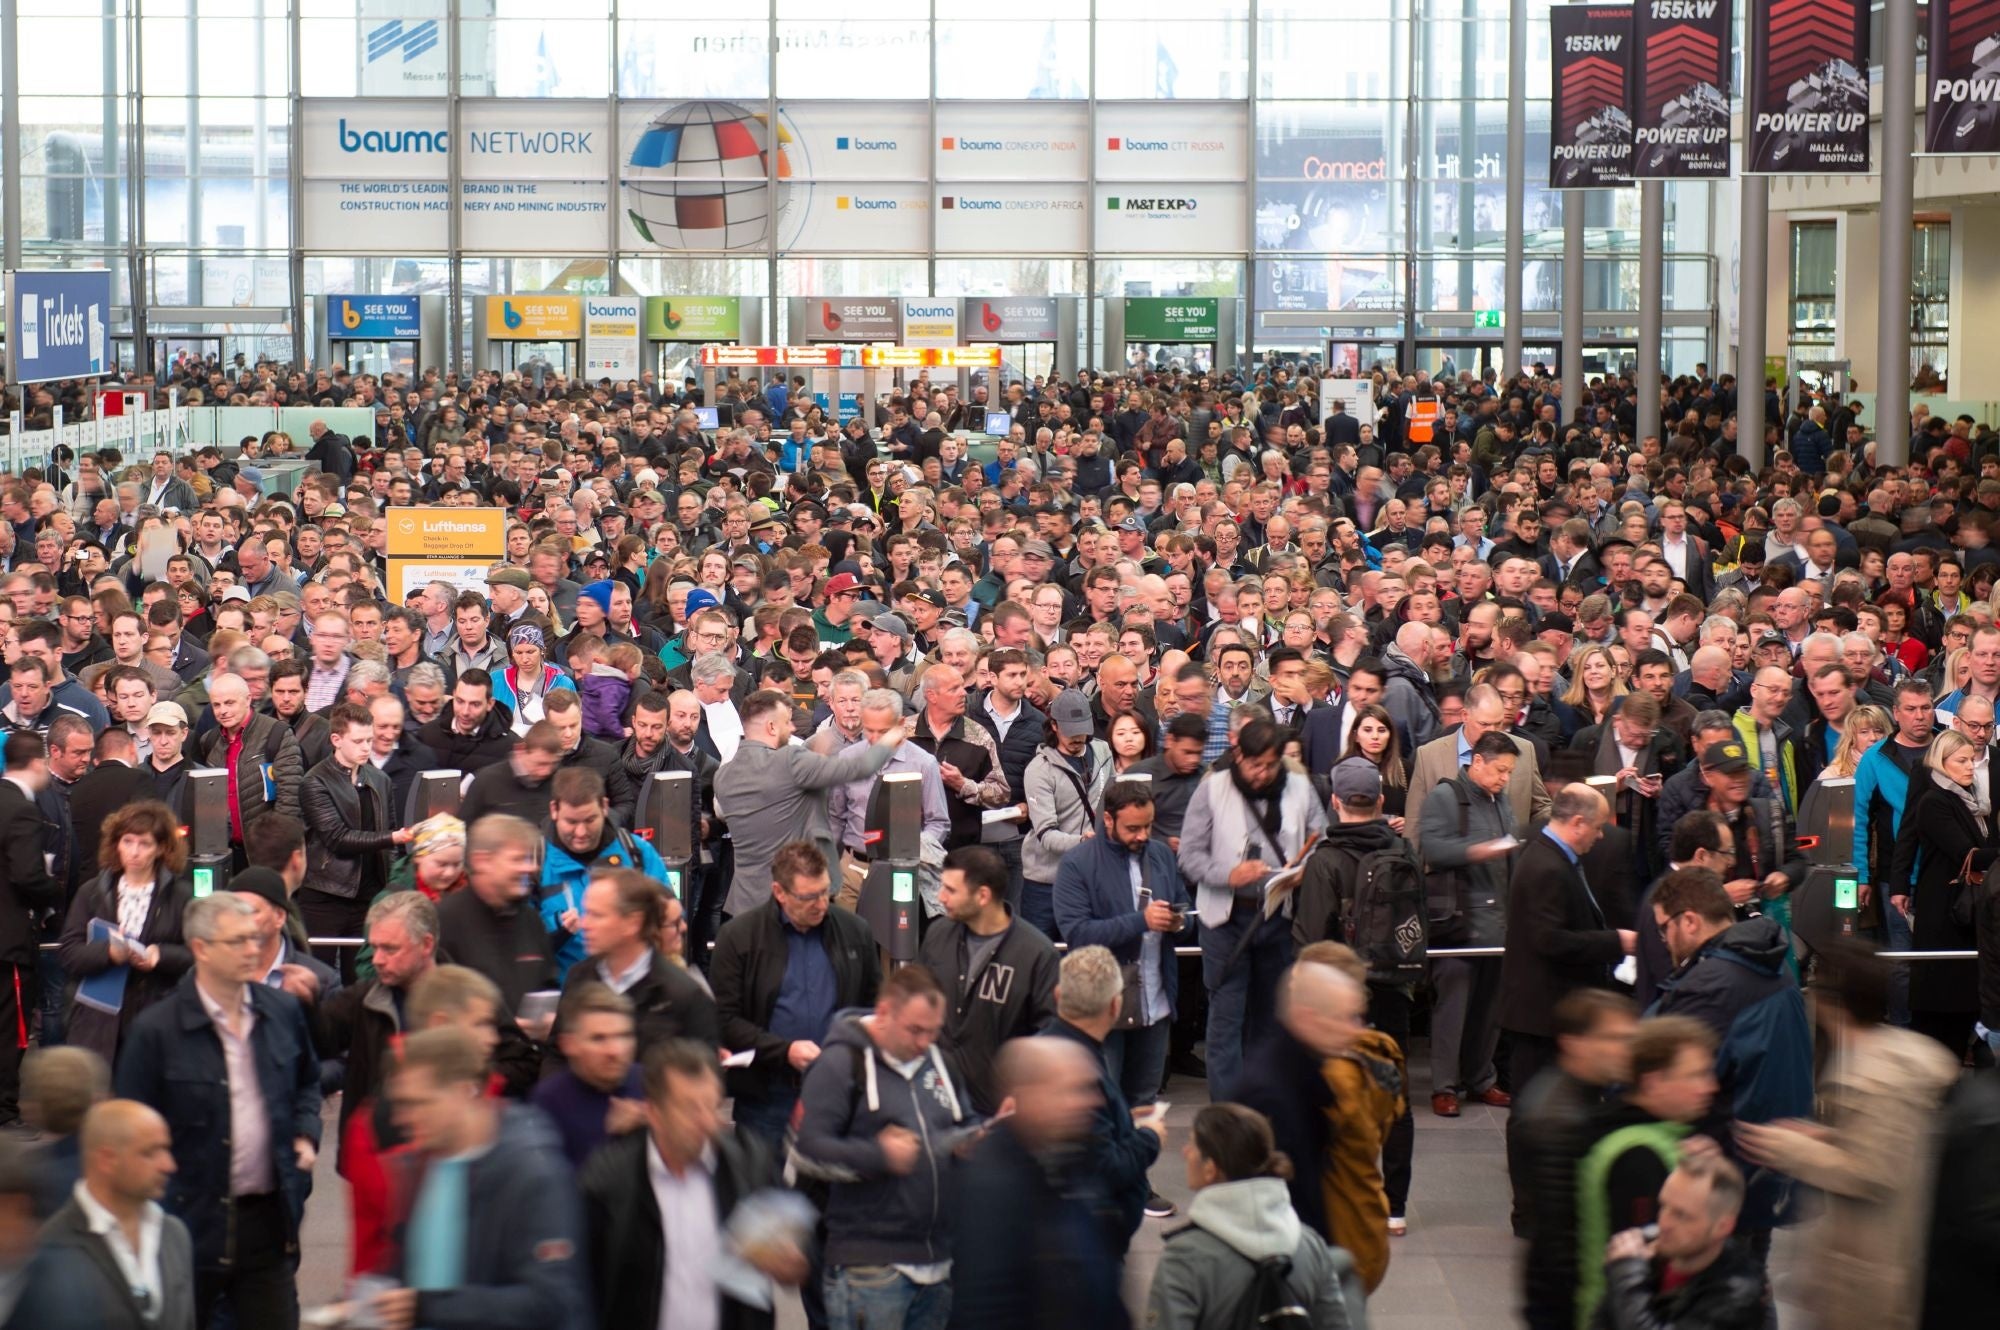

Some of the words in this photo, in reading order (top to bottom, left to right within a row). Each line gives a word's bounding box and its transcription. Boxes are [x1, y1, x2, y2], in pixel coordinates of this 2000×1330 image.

[1650, 0, 1718, 19] 155kW
[1564, 35, 1622, 52] 155kW
[437, 72, 483, 81] Mchen
[1756, 113, 1832, 132] POWER
[1836, 113, 1866, 132] UP
[339, 118, 448, 153] bauma
[471, 131, 593, 154] NETWORK
[1635, 127, 1698, 144] POWER
[1703, 127, 1728, 144] UP
[855, 137, 897, 150] bauma
[960, 137, 1002, 150] bauma
[1005, 141, 1049, 151] CONEXPO
[1051, 141, 1077, 151] INDIA
[1126, 137, 1168, 151] bauma
[1171, 141, 1188, 151] CTT
[1191, 141, 1225, 151] RUSSIA
[1809, 143, 1831, 153] HALL
[1554, 145, 1607, 160] POWER
[1611, 145, 1632, 159] UP
[1680, 153, 1699, 162] HALL
[1819, 153, 1848, 163] BOOTH
[1303, 156, 1386, 180] Connect
[1435, 152, 1500, 178] Hitchi
[1688, 161, 1712, 170] BOOTH
[341, 184, 360, 193] THE
[363, 184, 409, 193] WORLD'S
[412, 184, 449, 193] LEADIN
[463, 184, 500, 194] BRAND
[503, 184, 513, 194] IN
[516, 184, 537, 194] THE
[340, 201, 420, 211] CONSTRUCTION
[493, 202, 515, 211] AND
[518, 202, 554, 211] MINING
[556, 202, 607, 211] INDUSTRY
[855, 196, 897, 209] bauma
[960, 197, 1002, 210] bauma
[1005, 201, 1049, 210] CONEXPO
[1050, 201, 1084, 210] AFRICA
[1126, 199, 1156, 210] M&T
[1157, 198, 1197, 210] EXPO
[364, 304, 383, 315] SEE
[386, 304, 407, 315] YOU
[525, 305, 544, 315] SEE
[547, 305, 567, 315] YOU
[588, 302, 636, 317] bauma
[684, 305, 703, 316] SEE
[706, 305, 727, 316] YOU
[843, 306, 863, 316] SEE
[865, 306, 886, 316] YOU
[906, 303, 954, 317] bauma
[1004, 307, 1023, 317] SEE
[1026, 307, 1046, 317] YOU
[1165, 307, 1184, 317] SEE
[1186, 307, 1206, 317] YOU
[43, 293, 84, 347] Tickets
[394, 327, 419, 336] bauma
[423, 520, 487, 533] Lufthansa
[424, 569, 457, 577] Lufthansa
[979, 963, 1015, 1004] N
